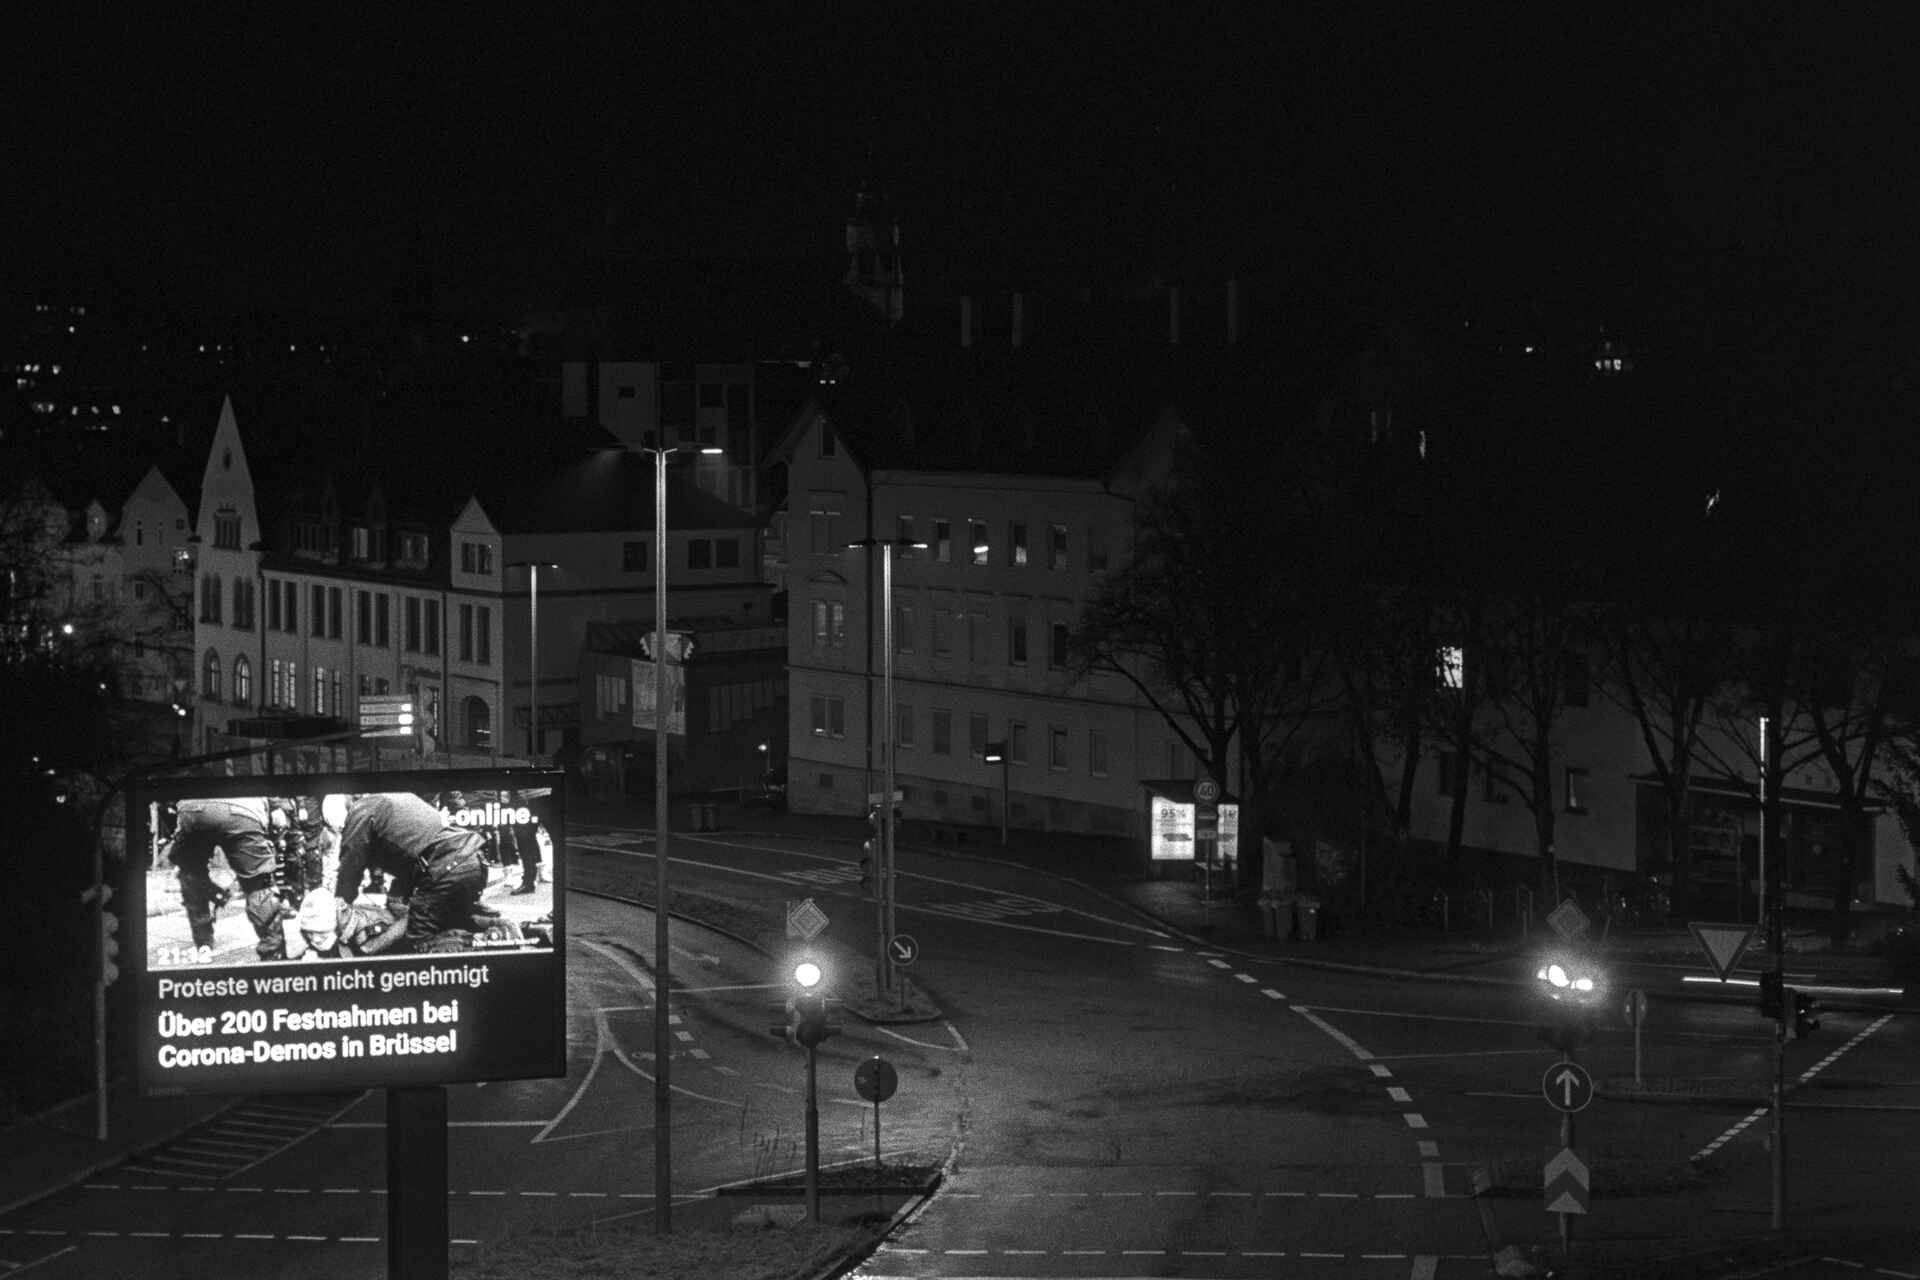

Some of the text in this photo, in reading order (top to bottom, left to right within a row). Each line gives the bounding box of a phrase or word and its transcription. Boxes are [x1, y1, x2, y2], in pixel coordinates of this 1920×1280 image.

[158, 964, 489, 1000] Proteste waren nicht genehmigt
[158, 999, 459, 1038] Über 200 Festnahmen bei
[158, 1029, 457, 1068] Corona-Demos in Brüssel
